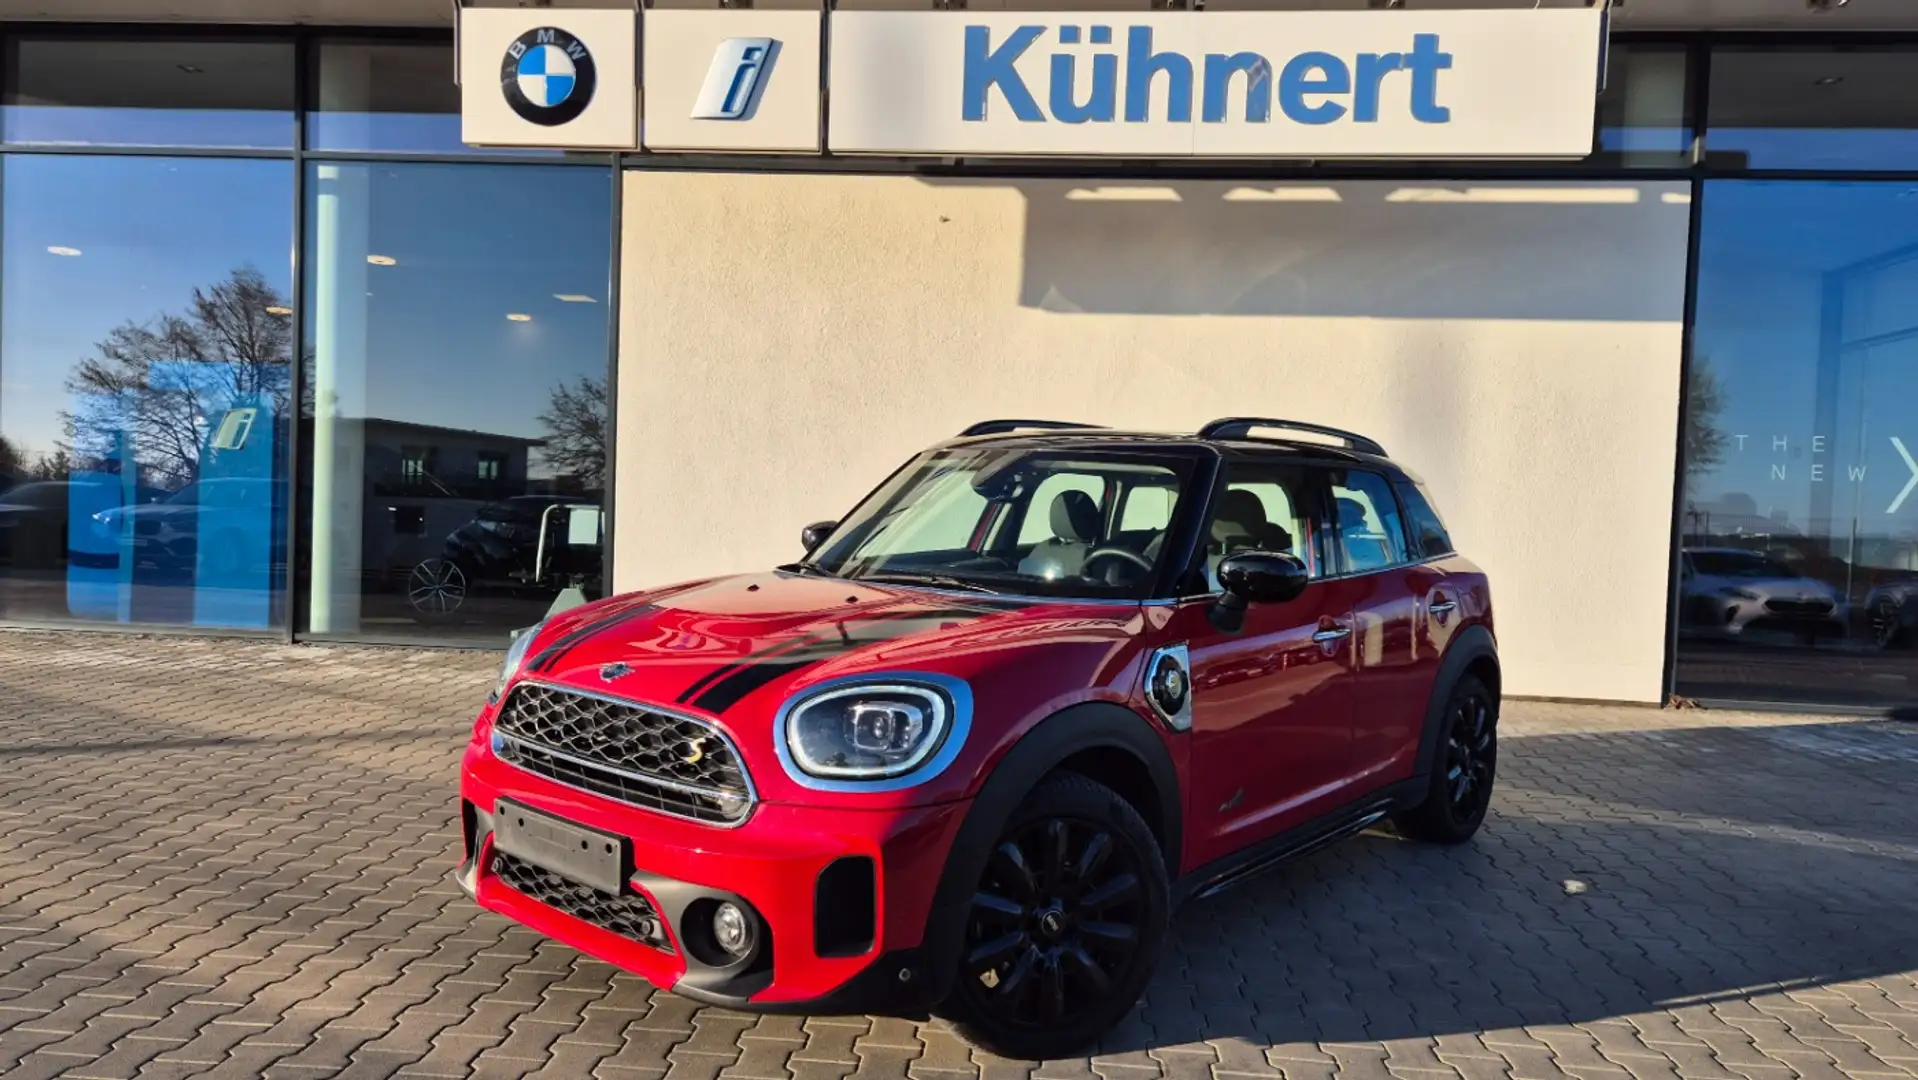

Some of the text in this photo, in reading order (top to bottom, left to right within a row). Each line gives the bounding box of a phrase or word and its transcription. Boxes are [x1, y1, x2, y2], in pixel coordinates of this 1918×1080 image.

[508, 29, 587, 61] BMW
[961, 24, 1453, 125] Kühnert
[1734, 434, 1826, 453] THE
[1770, 464, 1868, 482] NEW
